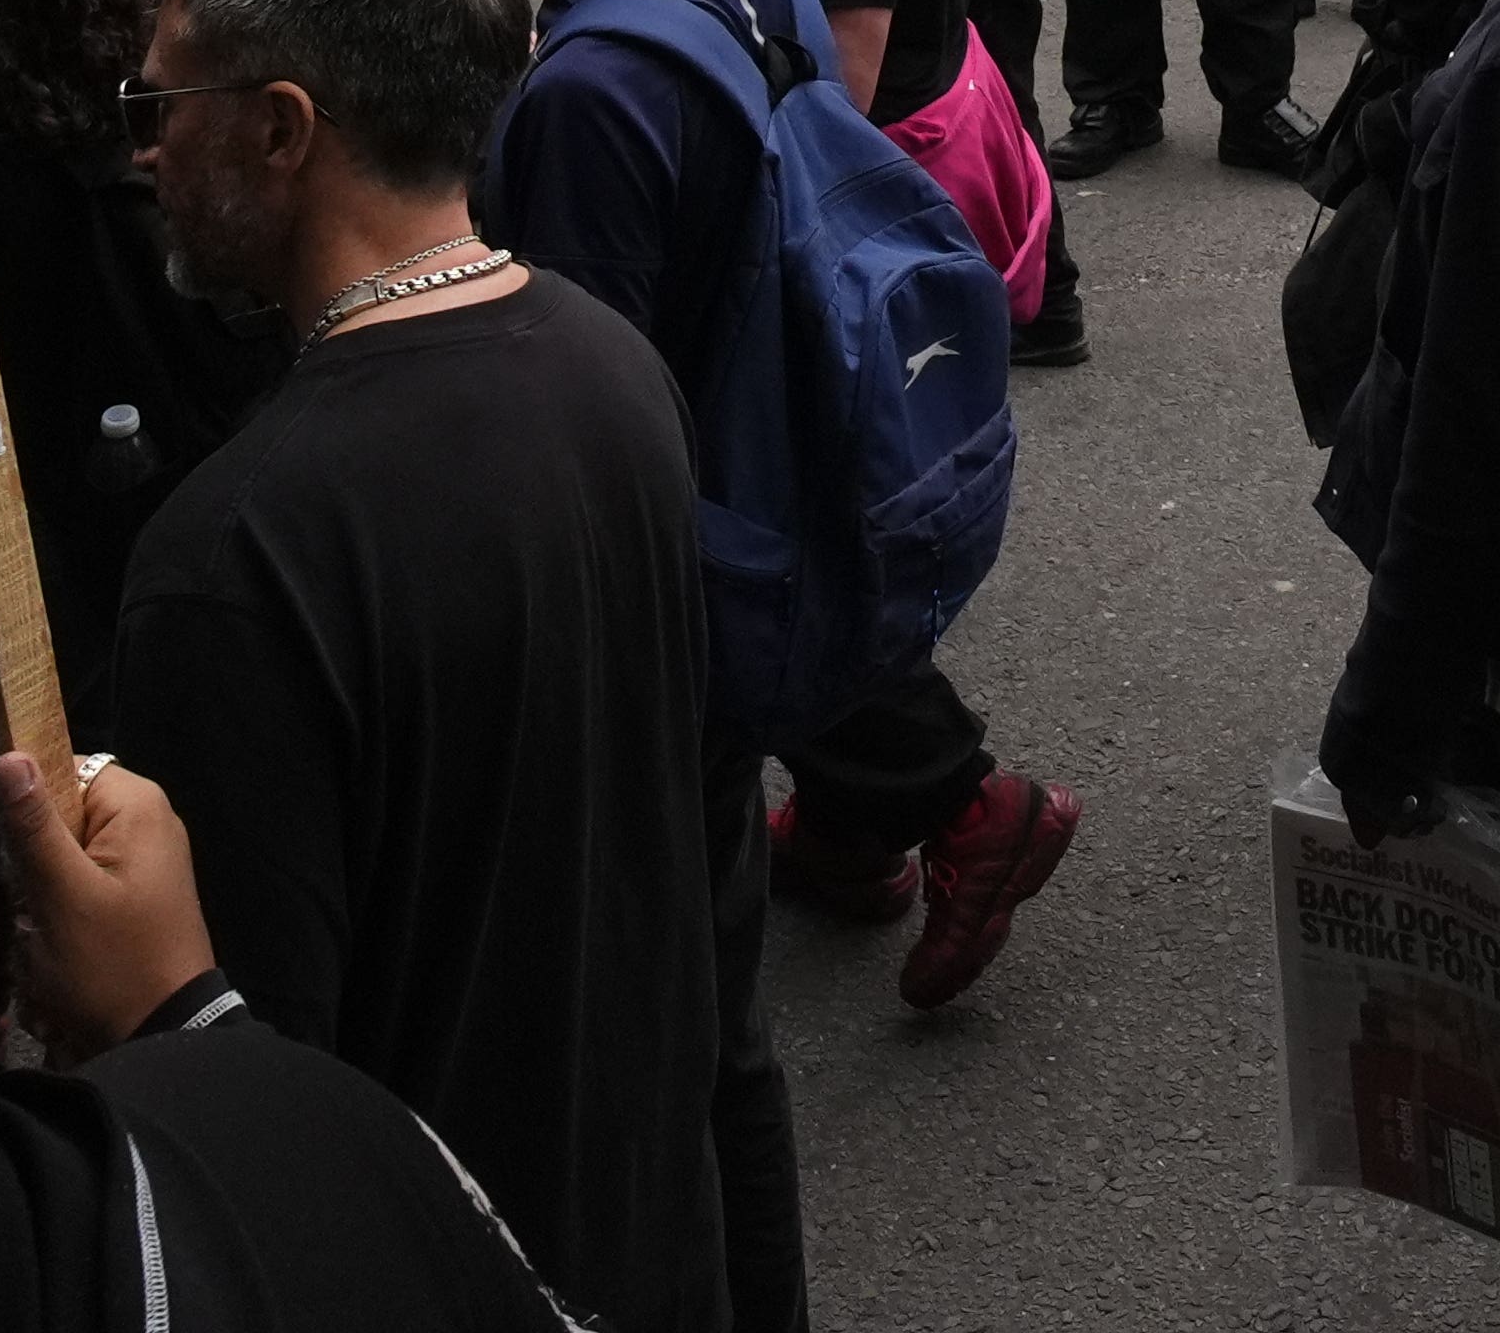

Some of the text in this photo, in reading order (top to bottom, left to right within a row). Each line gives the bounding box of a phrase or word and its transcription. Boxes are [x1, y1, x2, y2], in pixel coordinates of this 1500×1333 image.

[1296, 876, 1385, 929] BACK
[1300, 911, 1417, 967] STRIKE
[1426, 941, 1485, 993] FOR
